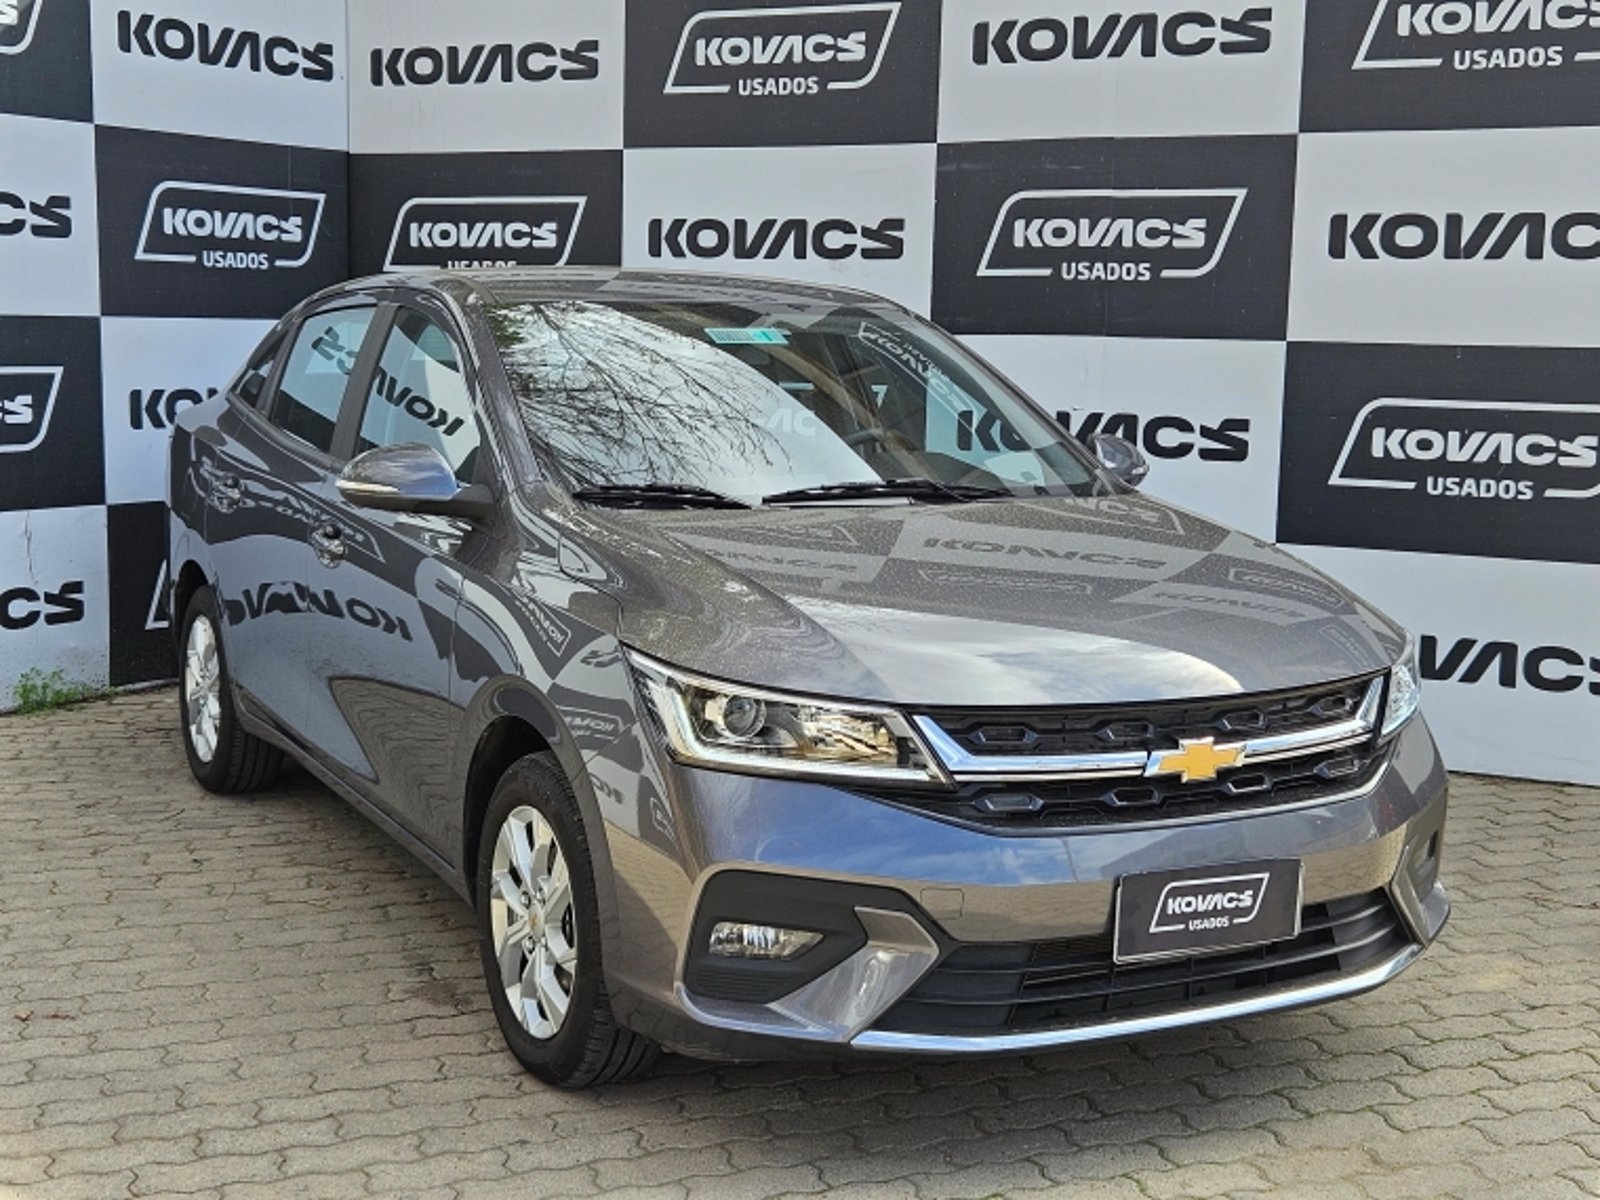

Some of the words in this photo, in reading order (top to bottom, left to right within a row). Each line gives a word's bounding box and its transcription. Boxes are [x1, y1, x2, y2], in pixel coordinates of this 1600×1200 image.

[118, 10, 333, 82] KOVACS
[696, 31, 866, 66] KOVACS
[972, 7, 1272, 65] KOVACS
[371, 40, 598, 86] KOVACS
[1453, 45, 1563, 70] USADOS
[738, 76, 819, 96] USADOS
[163, 207, 303, 242] KOVACS
[409, 222, 558, 248] KOVACS
[648, 218, 905, 260] KOVACS
[1013, 217, 1207, 248] KOVACS
[202, 250, 269, 270] USADOS
[1061, 262, 1151, 281] USADOS
[1371, 427, 1599, 468] KOVACS
[1426, 476, 1534, 500] USADOS
[1418, 634, 1600, 696] VAC
[1166, 889, 1254, 915] KOVACS
[1188, 915, 1230, 931] USADOS
